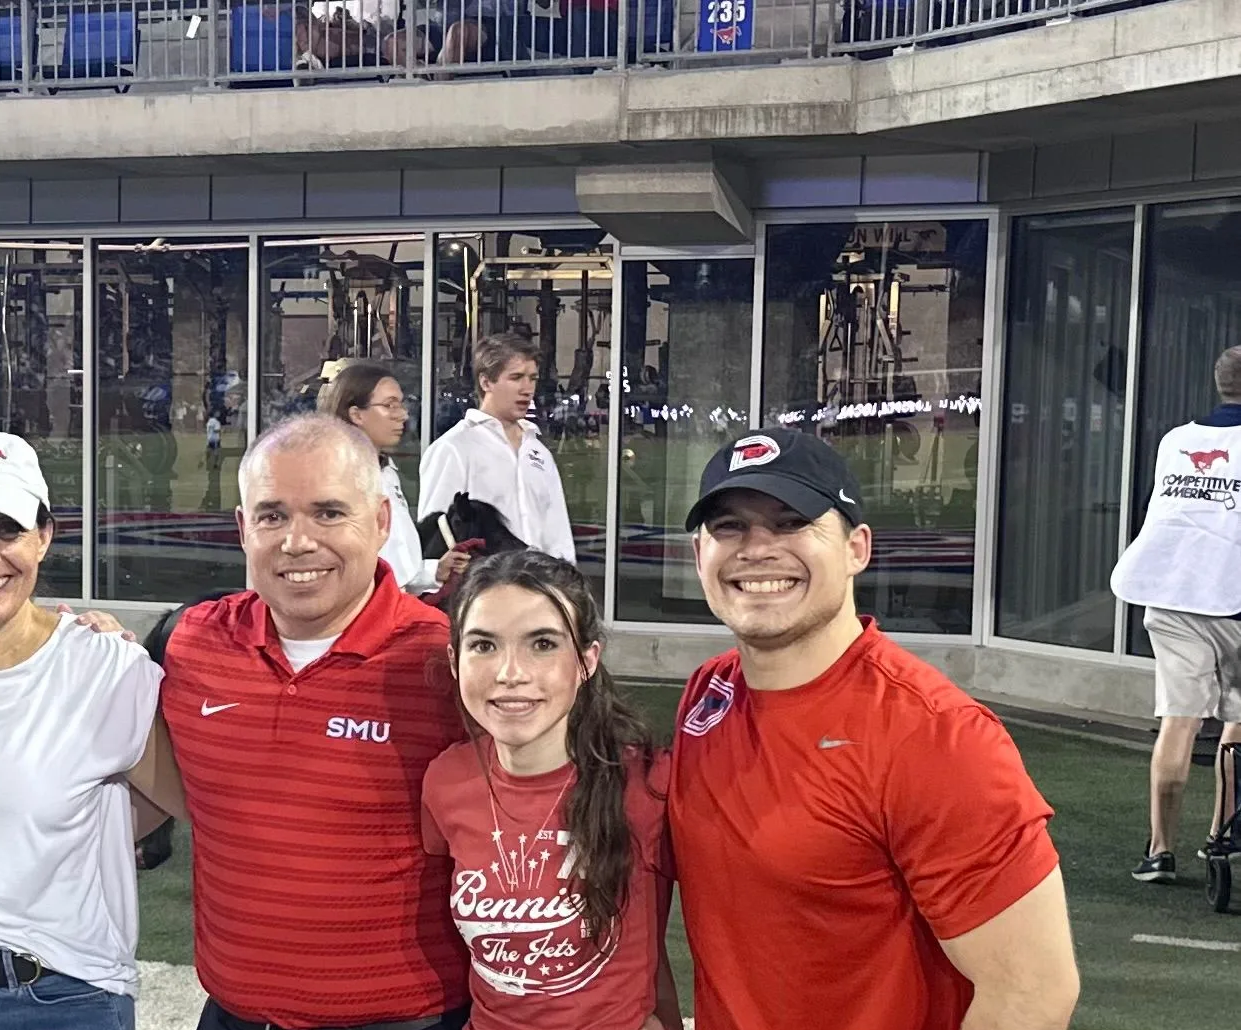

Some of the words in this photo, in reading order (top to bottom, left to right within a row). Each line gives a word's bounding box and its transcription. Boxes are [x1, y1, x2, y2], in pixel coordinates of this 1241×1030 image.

[707, 0, 746, 23] 235
[325, 716, 391, 744] SMU
[481, 937, 521, 964] The
[523, 931, 581, 966] Jets
